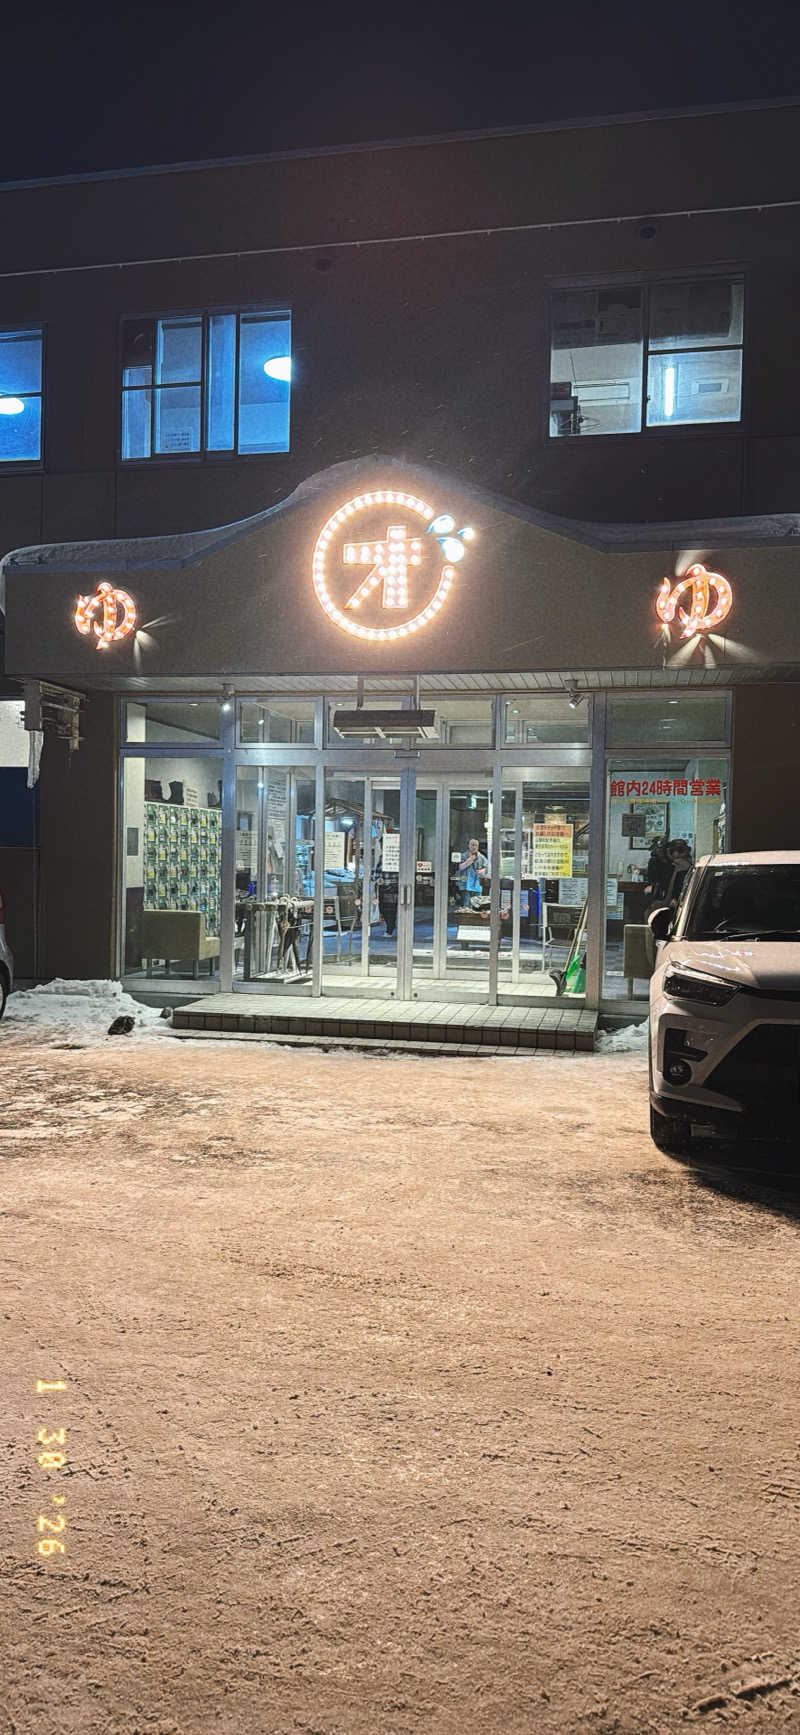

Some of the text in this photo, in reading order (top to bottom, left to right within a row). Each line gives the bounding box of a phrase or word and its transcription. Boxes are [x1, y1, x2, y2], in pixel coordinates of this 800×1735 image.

[343, 525, 422, 610] オ
[656, 563, 733, 640] ゆ
[75, 582, 136, 649] ゆ
[610, 778, 721, 797] 館内24時間営業
